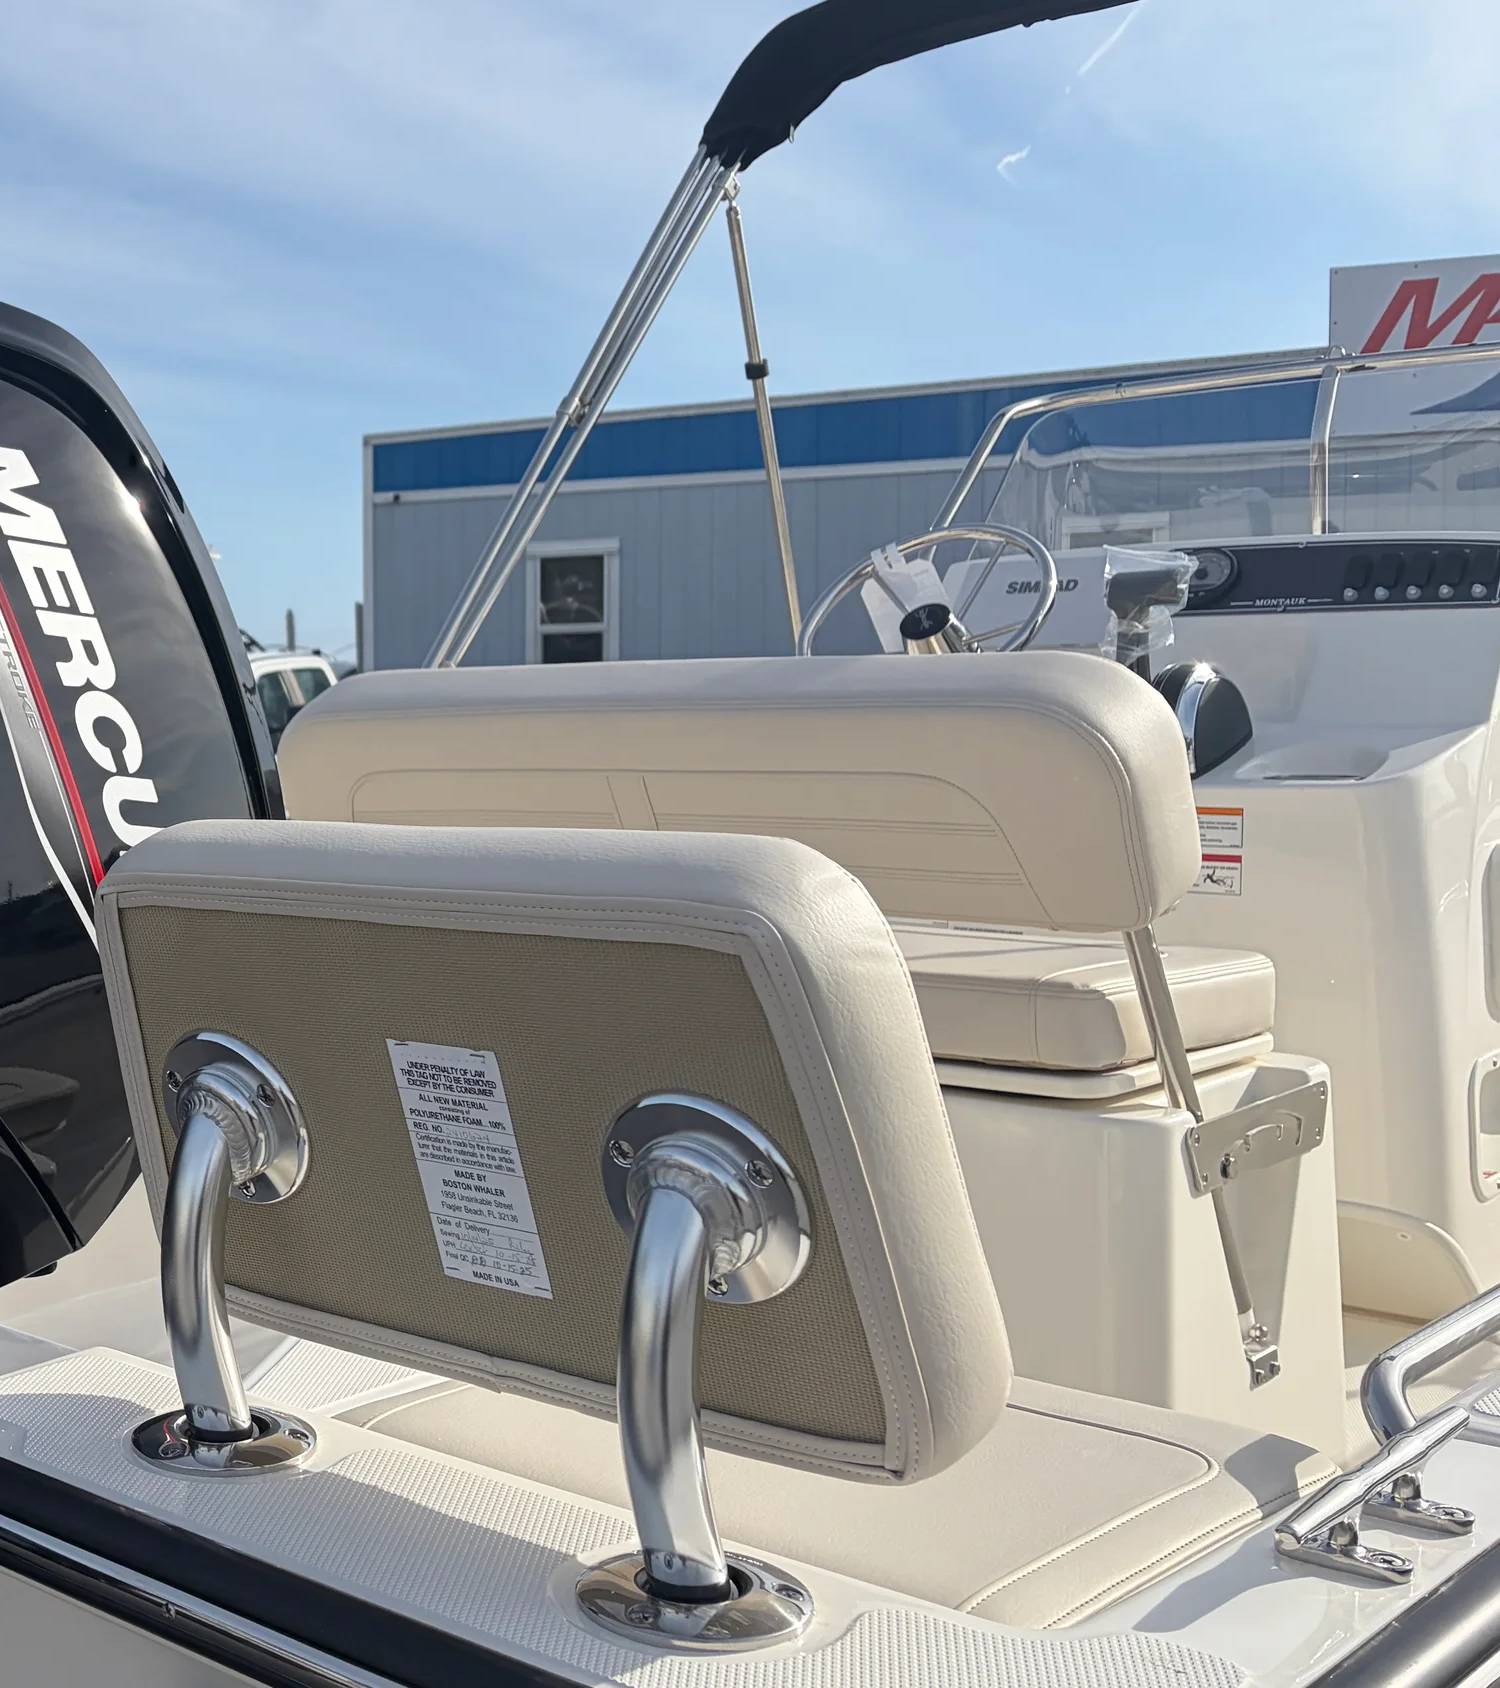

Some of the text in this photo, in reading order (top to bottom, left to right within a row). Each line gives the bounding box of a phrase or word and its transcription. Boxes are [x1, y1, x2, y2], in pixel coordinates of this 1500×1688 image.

[1005, 579, 1079, 594] SIMAD
[1255, 597, 1306, 606] MONTAUK
[407, 1061, 429, 1070] UNDER
[431, 1065, 458, 1075] PENALTY
[470, 1070, 485, 1078] LAW
[400, 1068, 414, 1077] THIS
[416, 1071, 428, 1079] TAG
[429, 1073, 442, 1081] NOT
[454, 1077, 463, 1085] BE
[464, 1078, 496, 1089] REMOVED
[407, 1078, 494, 1097] EXCEPT BY THE CONSUMER
[419, 1094, 488, 1111] ALL NEW MATERIAL
[409, 1108, 460, 1123] POLYURETHANE
[413, 1122, 444, 1133] REG. NO.
[416, 1133, 446, 1146] Certification
[453, 1139, 467, 1149] made
[469, 1141, 475, 1151] by
[476, 1142, 485, 1151] the
[430, 1153, 455, 1162] described
[462, 1159, 493, 1169] accordance
[494, 1162, 505, 1171] with
[454, 1148, 478, 1158] materials
[487, 1153, 496, 1161] this
[499, 1156, 514, 1164] article
[454, 1170, 486, 1182] MADE BY
[442, 1179, 505, 1197] BOSTON WHALER
[441, 1191, 514, 1211] 1958 Unsinkable Street
[442, 1201, 518, 1223] Flagler Beach, FL 32136
[437, 1217, 451, 1226] Date
[440, 1229, 460, 1240] Sewing
[446, 1251, 469, 1262] Final QC
[473, 1271, 494, 1281] MADE
[504, 1278, 519, 1287] USA
